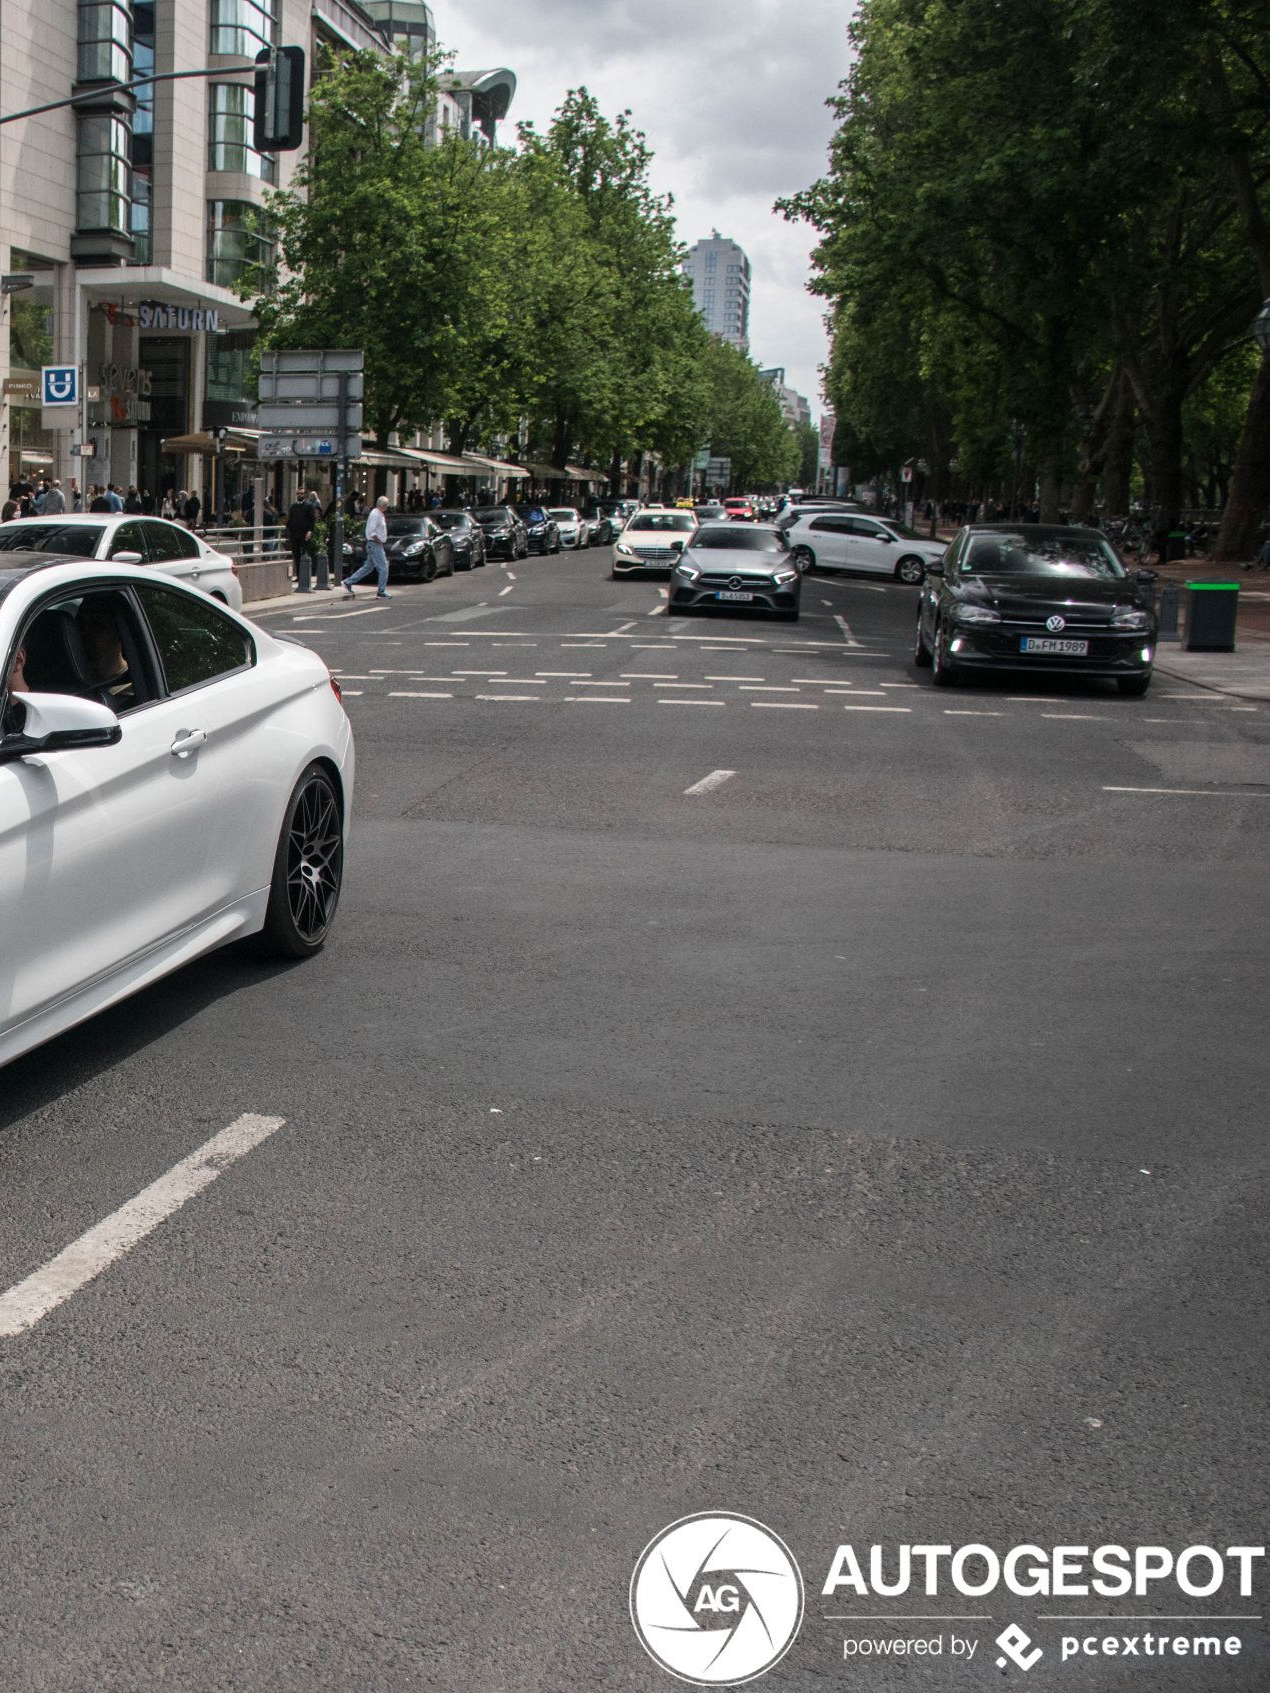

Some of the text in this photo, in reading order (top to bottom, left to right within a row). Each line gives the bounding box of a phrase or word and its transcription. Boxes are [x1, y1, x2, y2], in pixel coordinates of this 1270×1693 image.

[139, 305, 219, 331] SATURN
[126, 399, 152, 421] SATURN
[1027, 640, 1035, 649] D
[1058, 642, 1086, 652] 1989
